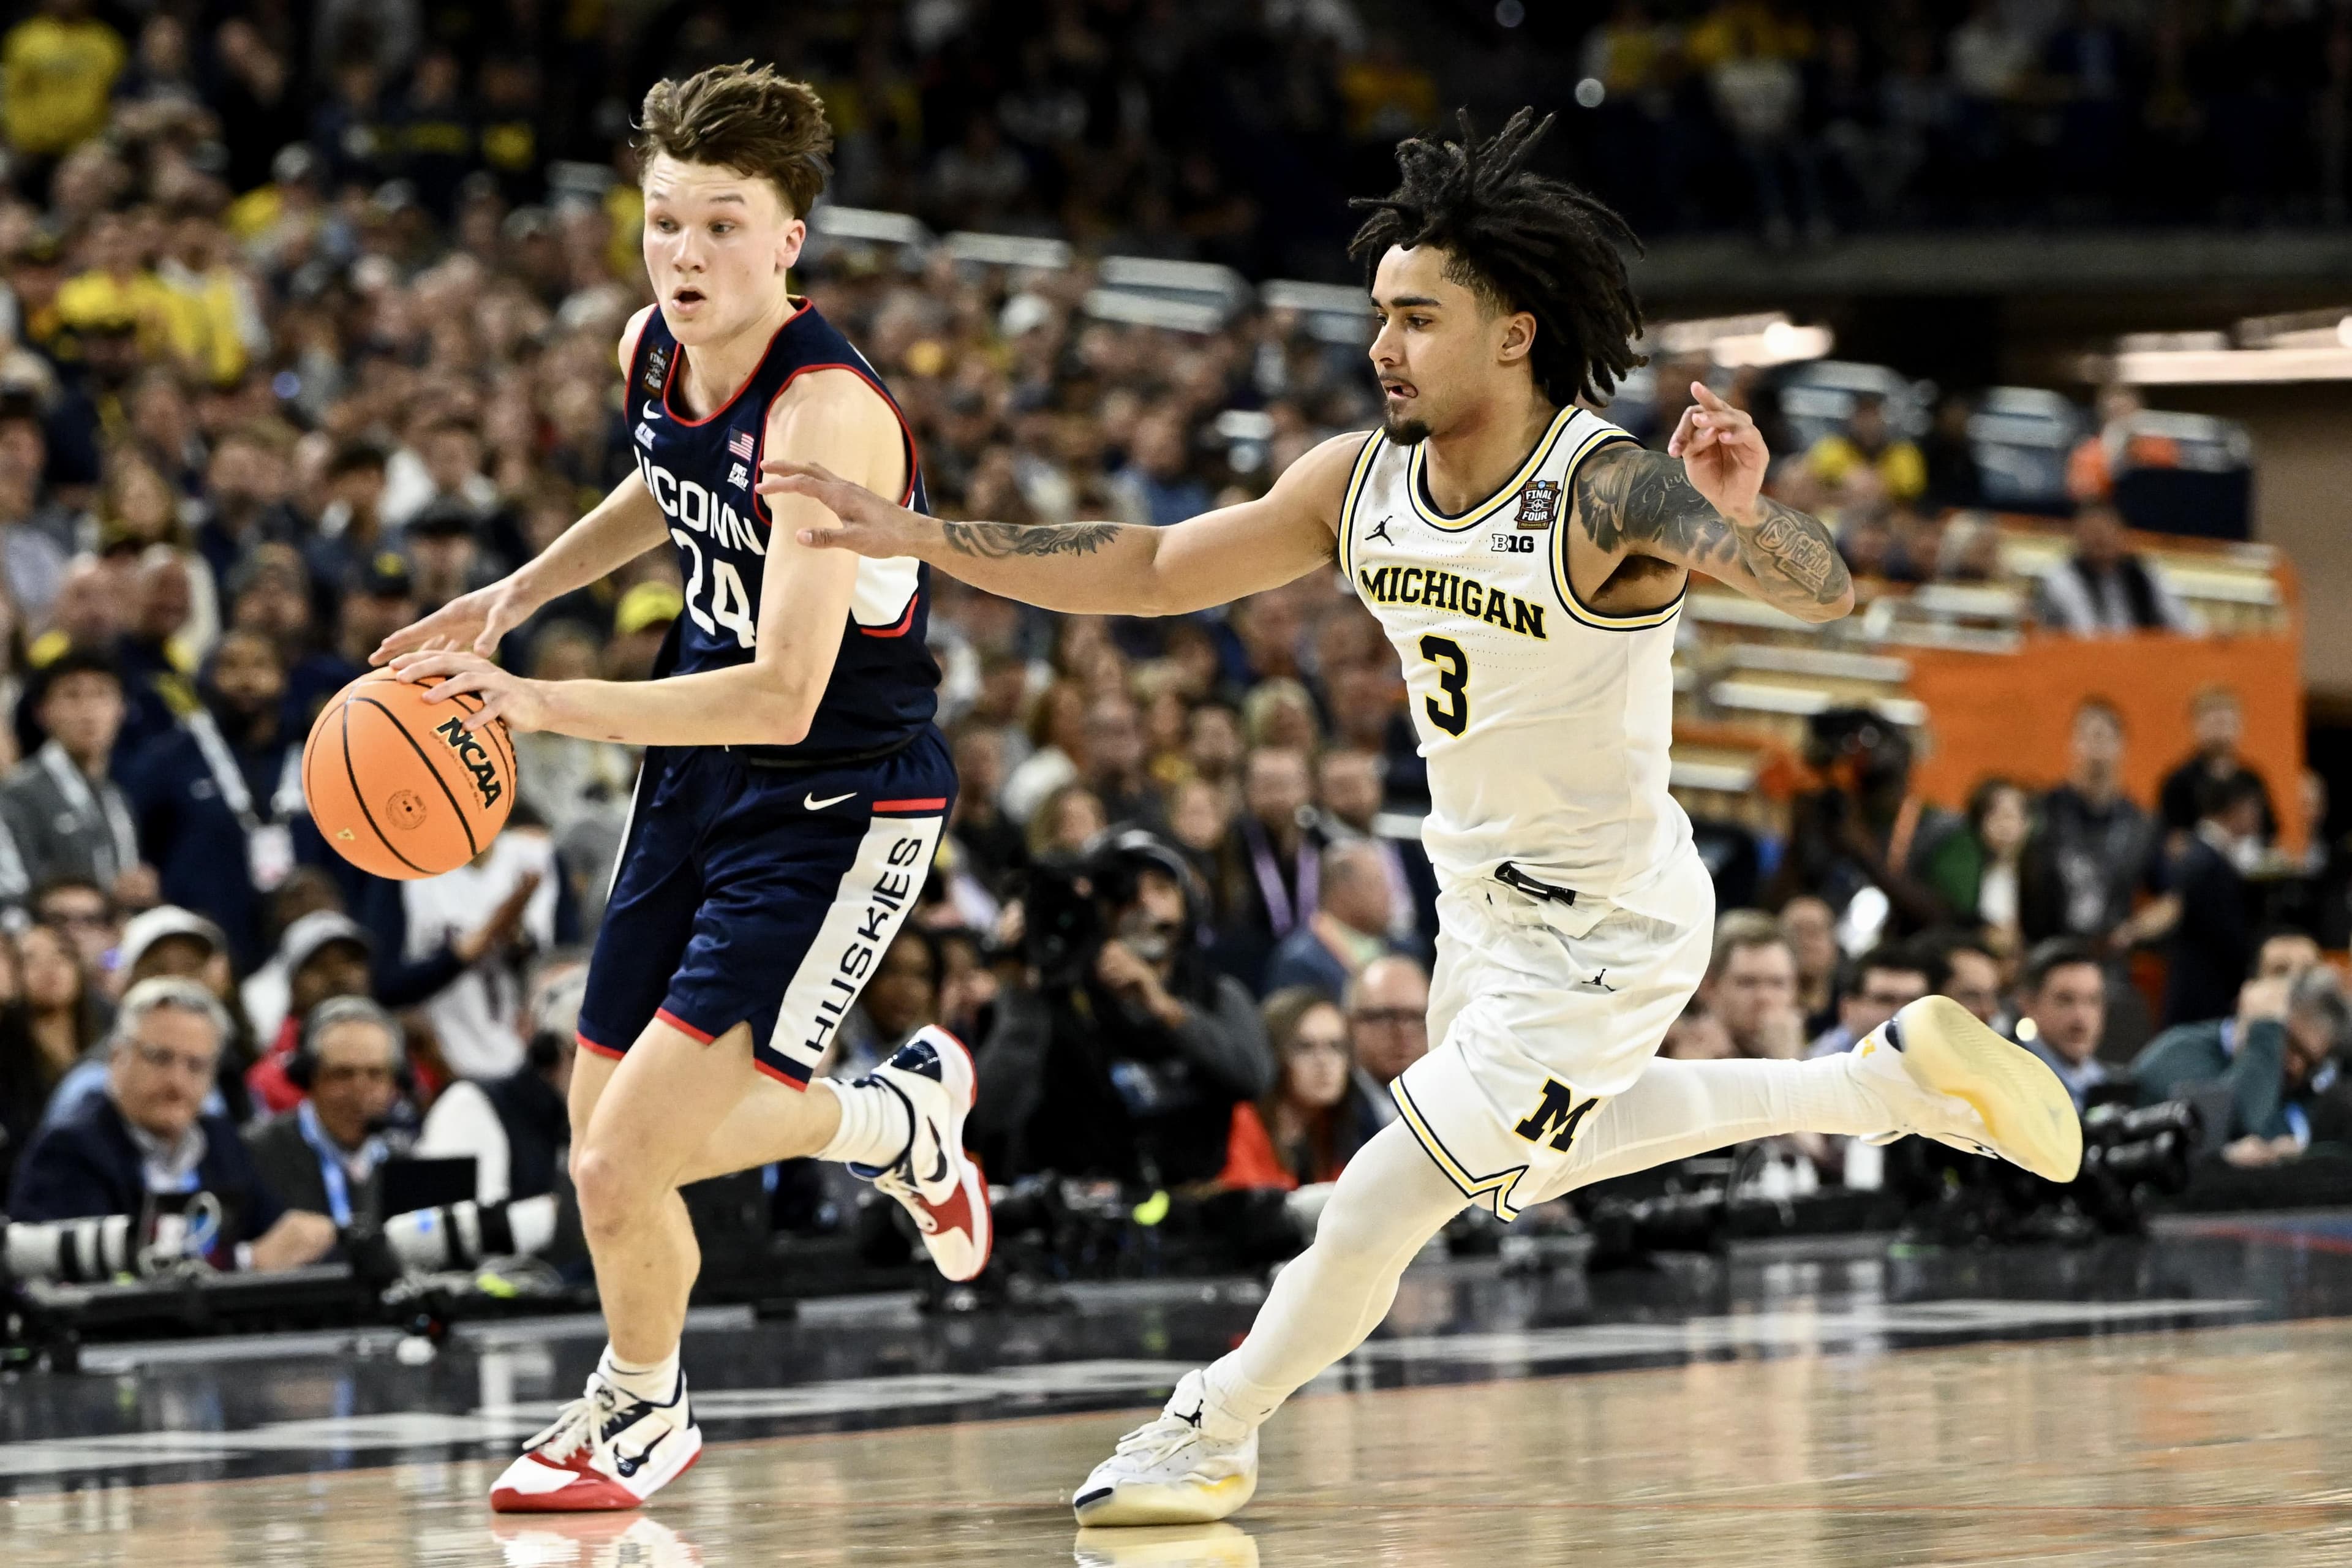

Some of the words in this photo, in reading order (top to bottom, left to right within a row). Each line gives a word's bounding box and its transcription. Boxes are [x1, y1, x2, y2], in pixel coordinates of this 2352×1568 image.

[633, 444, 765, 556] UCONN
[1521, 511, 1548, 521] FOUR
[1526, 490, 1552, 500] FINAL
[671, 528, 756, 648] 24
[1359, 567, 1548, 641] MICHIGAN
[1419, 634, 1469, 739] 3
[436, 716, 502, 810] NCAA
[805, 837, 922, 1054] HUSKIES
[1513, 1077, 1599, 1154] M
